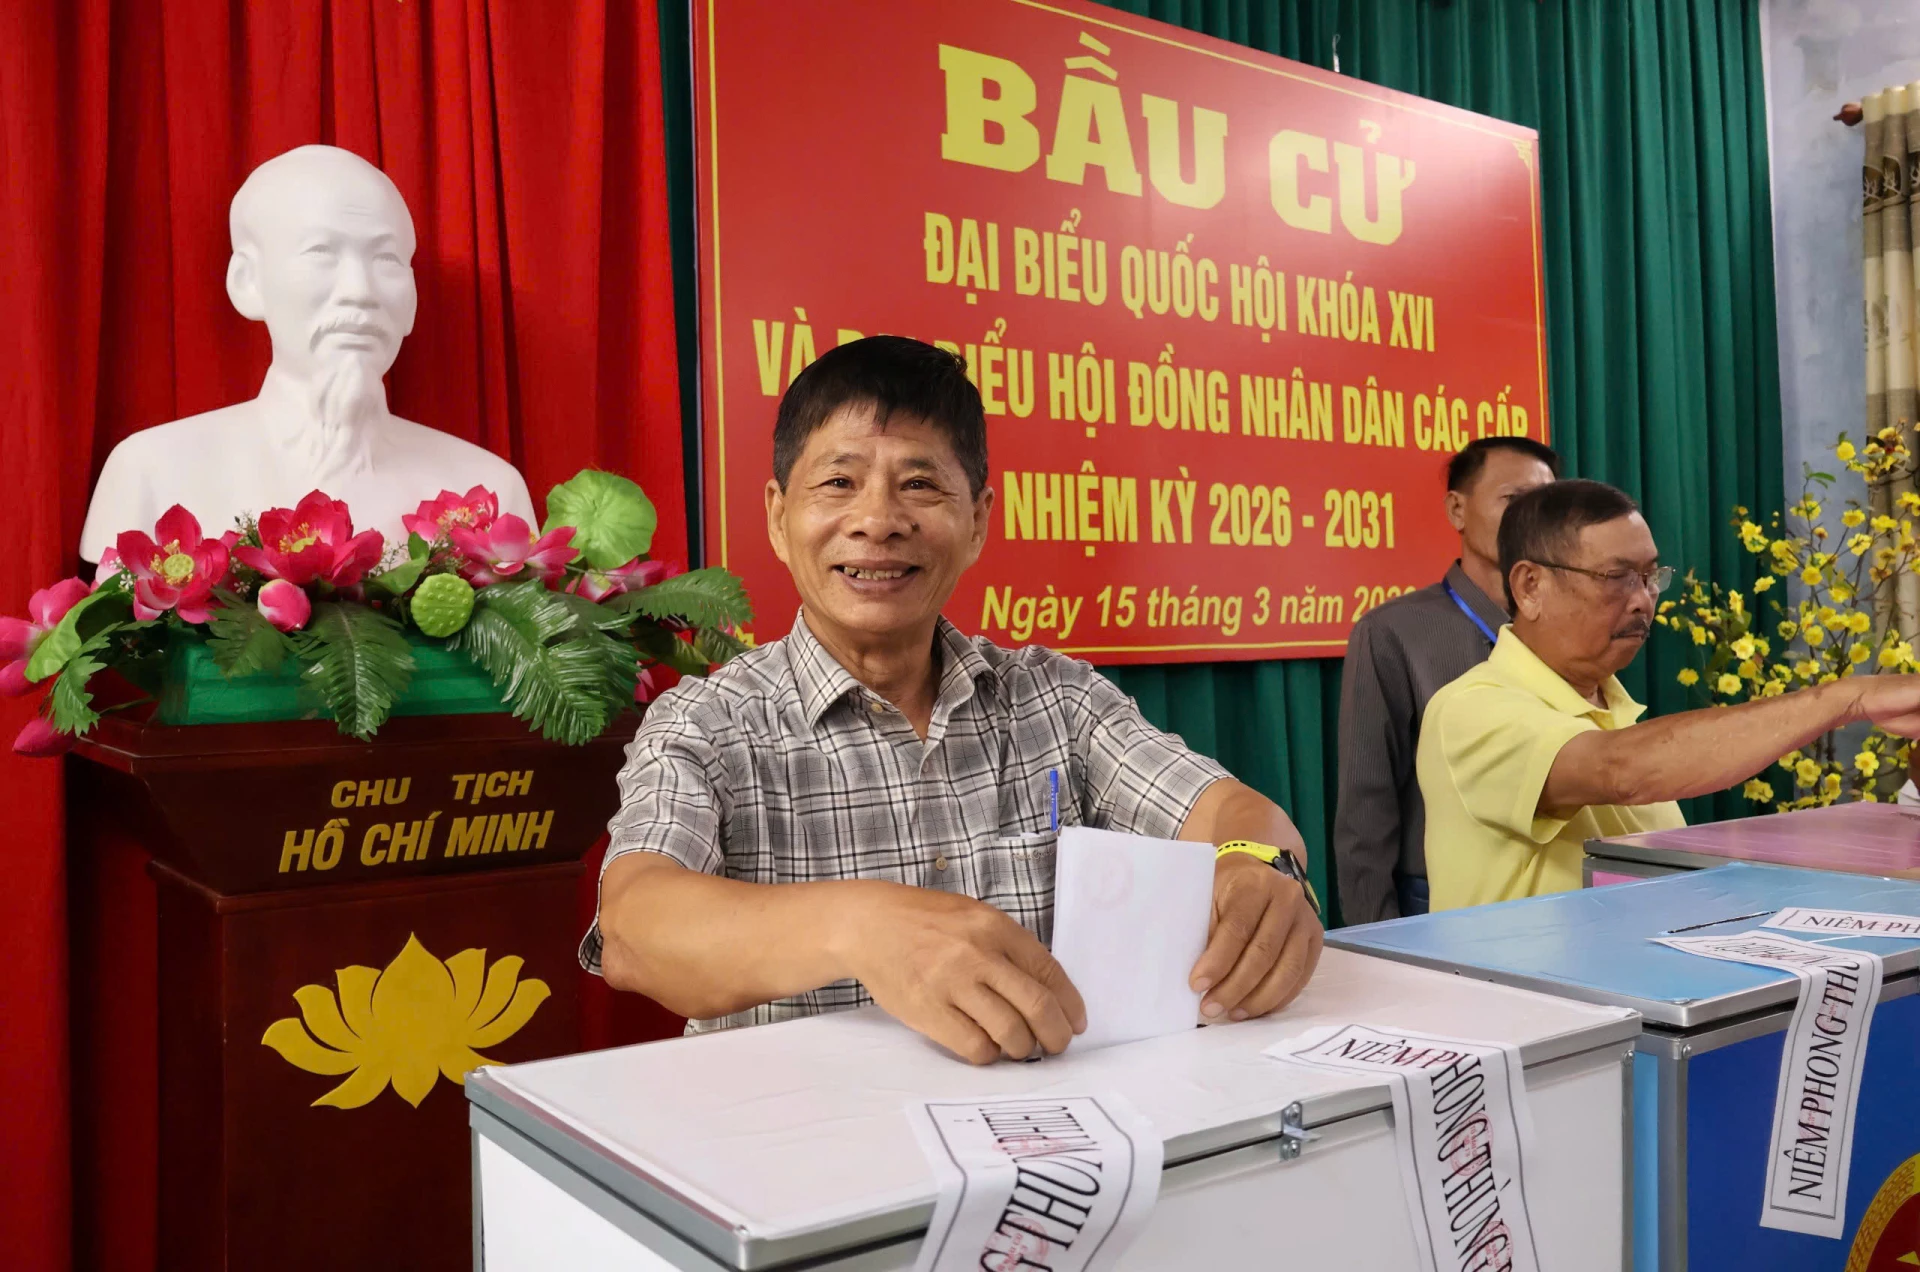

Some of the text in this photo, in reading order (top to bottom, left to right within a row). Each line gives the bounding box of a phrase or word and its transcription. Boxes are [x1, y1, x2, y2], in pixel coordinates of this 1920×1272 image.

[939, 31, 1416, 246] BẦU CỬ
[924, 208, 1435, 352] ĐẠI BIỂU QUỐC HỘI KHÓA XVI
[1048, 342, 1116, 438] HỘI
[1128, 343, 1230, 434] ĐỒNG
[1240, 367, 1333, 442] NHÂN
[1341, 376, 1405, 448] DÂN
[1413, 384, 1469, 453] CÁC
[1003, 460, 1395, 557] NHIỆM KỲ 2026 - 2031
[981, 584, 1417, 641] Ngày 15 tháng 3 năm 20
[452, 770, 534, 804] TỊCH
[278, 810, 554, 873] HỒ CHÍ MINH
[1803, 916, 1878, 931] NIÊM
[1321, 1038, 1433, 1067] NIÊM
[1417, 1050, 1488, 1162] PHONG
[1801, 1012, 1847, 1117] PHONG
[1783, 1119, 1831, 1201] NIÊM
